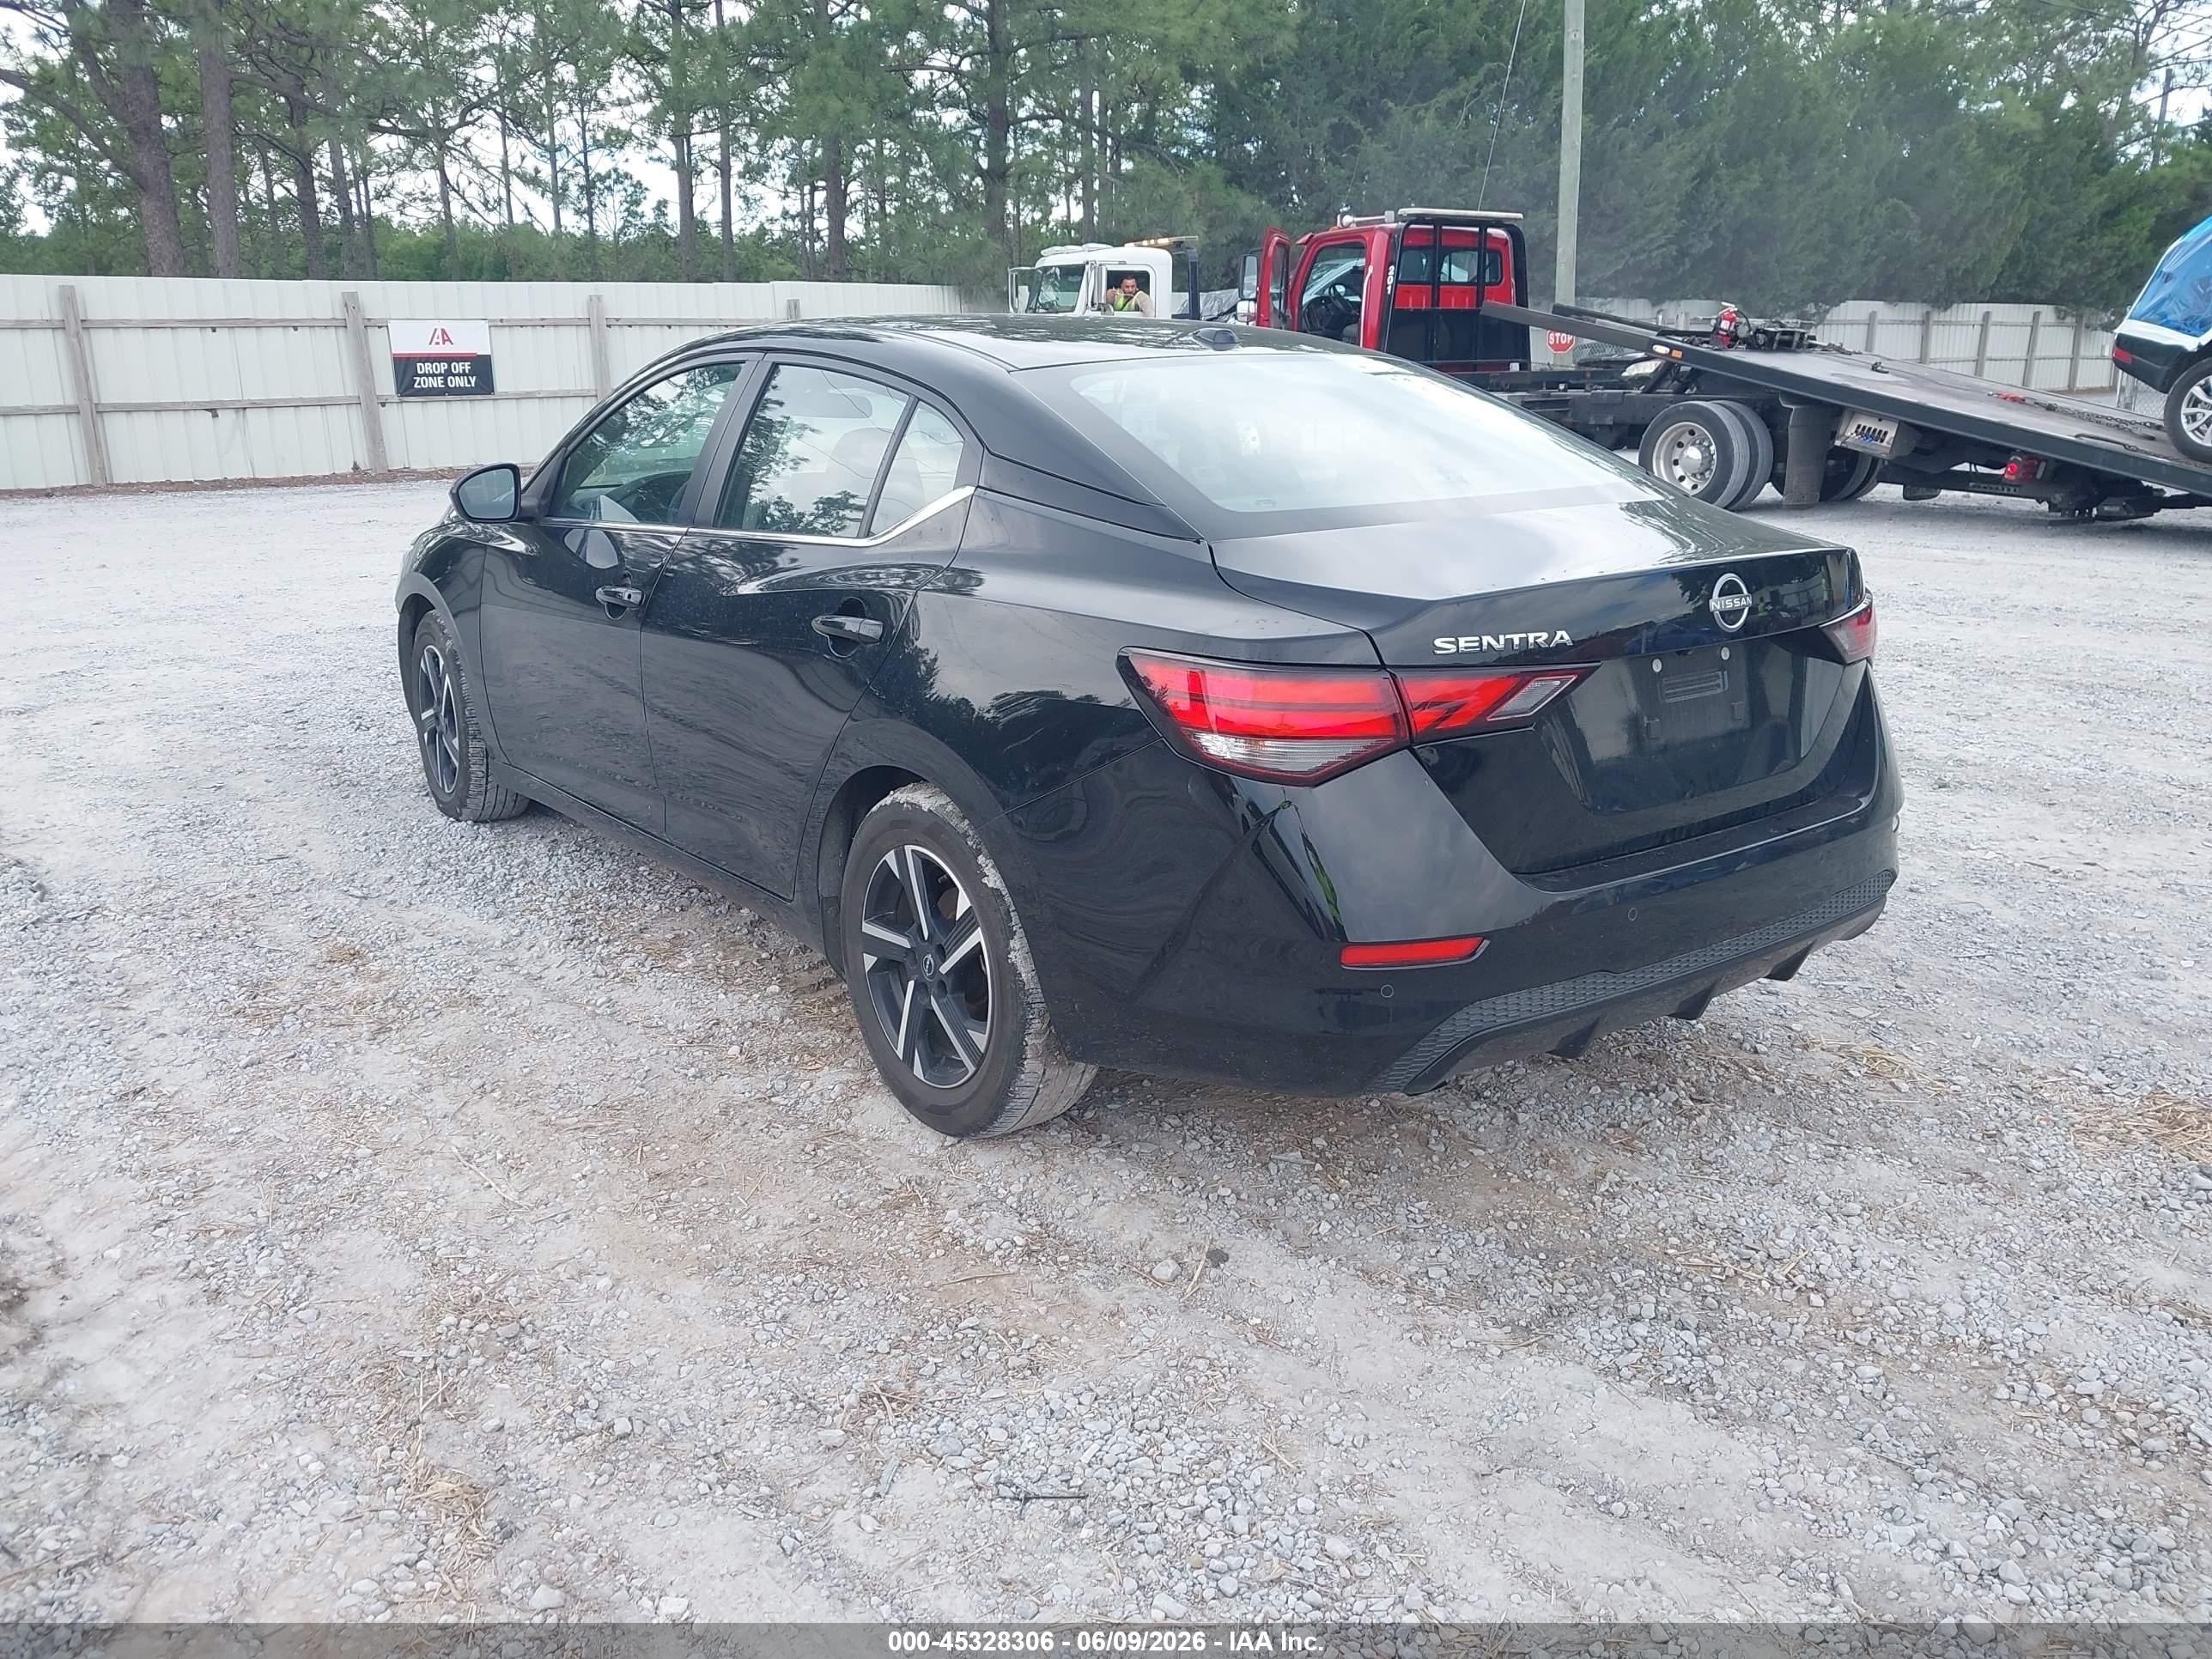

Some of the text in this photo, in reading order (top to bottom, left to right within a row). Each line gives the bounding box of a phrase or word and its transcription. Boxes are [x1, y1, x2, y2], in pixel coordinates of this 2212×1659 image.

[1387, 264, 1395, 295] 201
[1548, 331, 1573, 345] STOP
[416, 362, 471, 374] DROP OFF
[413, 375, 477, 388] ZONE ONLY
[1711, 596, 1753, 611] NISSAN
[1433, 629, 1574, 655] SENTRA
